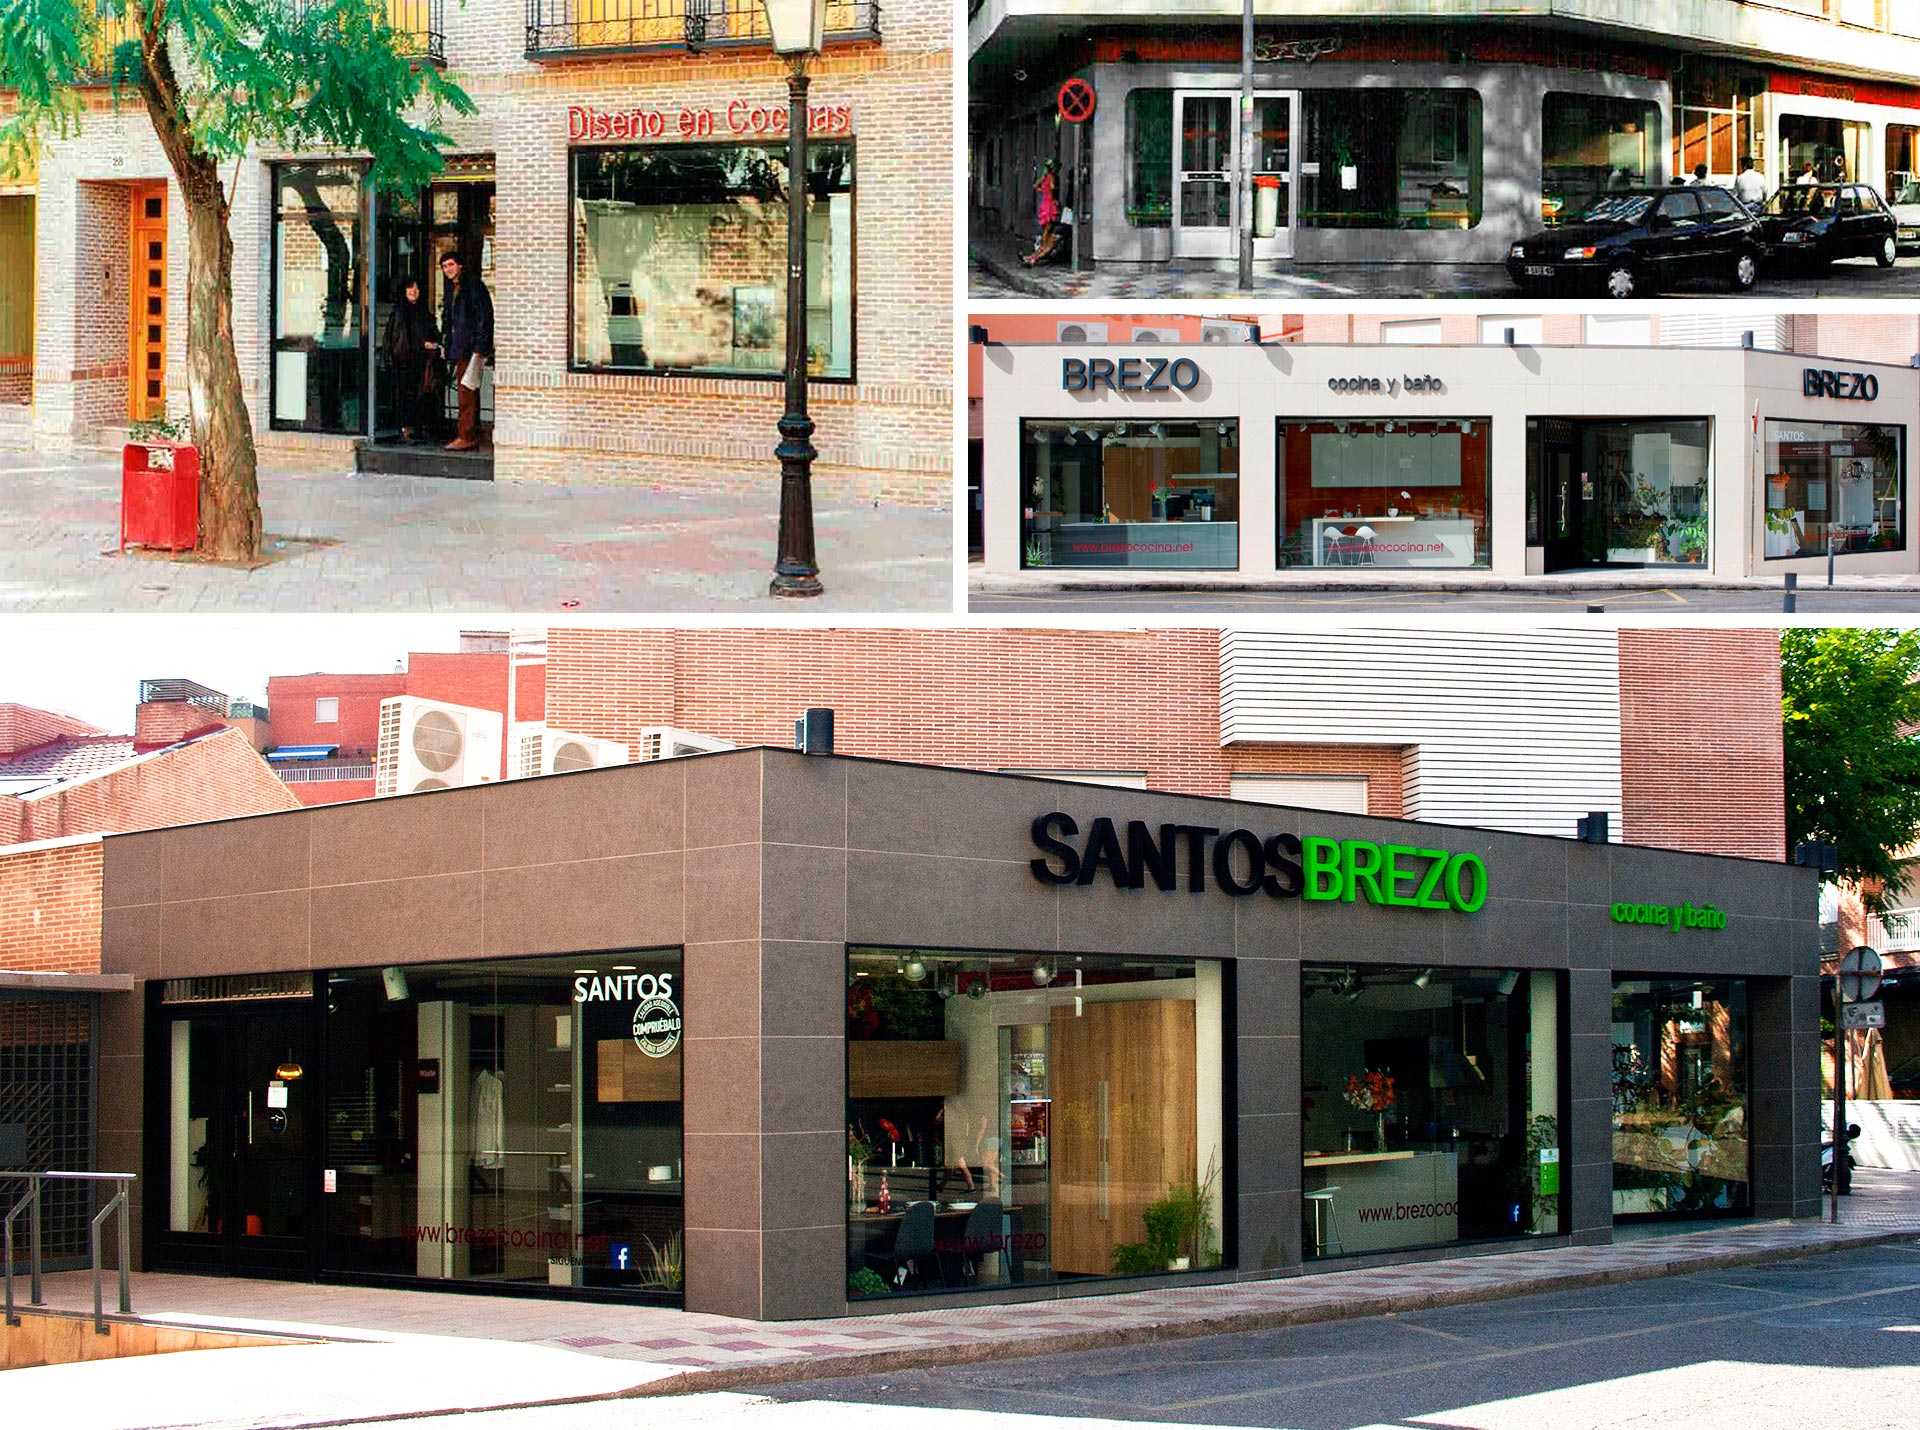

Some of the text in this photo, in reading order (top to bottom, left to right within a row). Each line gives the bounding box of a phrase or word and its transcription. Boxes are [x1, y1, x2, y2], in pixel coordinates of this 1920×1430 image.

[567, 97, 851, 140] Diseño en Cocas
[1062, 357, 1200, 391] BREZO
[1327, 374, 1442, 394] cocina y baño
[1803, 368, 1879, 401] BREZO
[1774, 430, 1805, 441] SANTOS
[1072, 541, 1194, 553] www.brezococina.net
[1611, 901, 1727, 933] cocina y baño
[574, 973, 673, 1003] SANTOS
